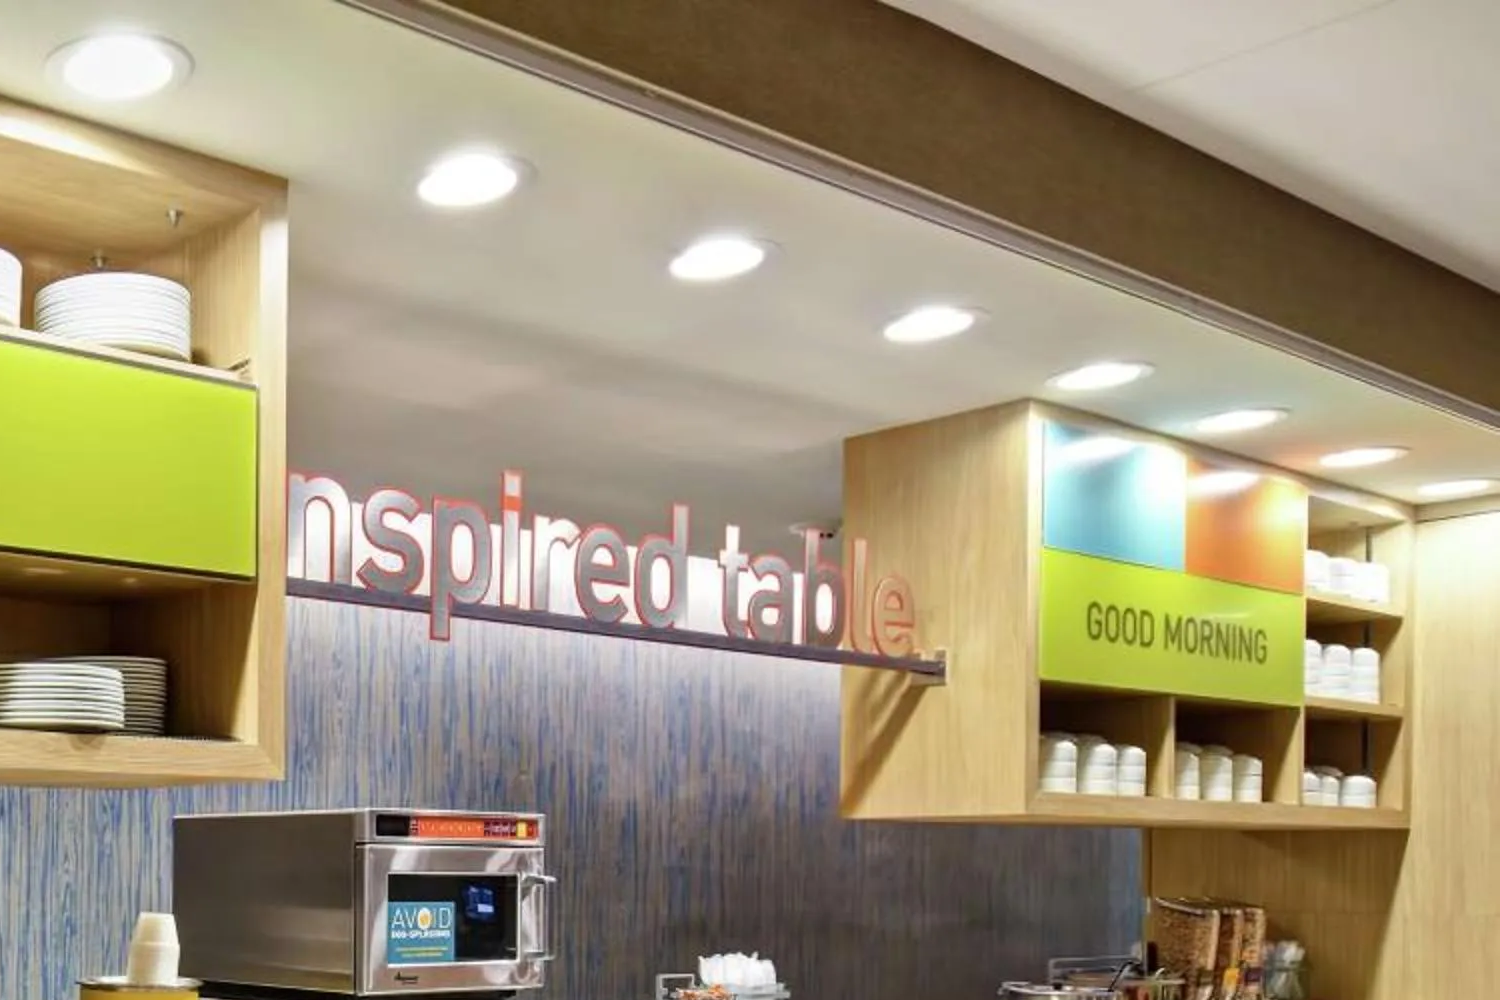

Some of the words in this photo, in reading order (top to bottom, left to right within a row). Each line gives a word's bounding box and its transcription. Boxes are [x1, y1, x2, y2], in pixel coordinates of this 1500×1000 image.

[717, 523, 916, 658] table
[1086, 600, 1155, 649] GOOD
[1163, 612, 1268, 666] MORNING
[391, 906, 452, 930] AVOID
